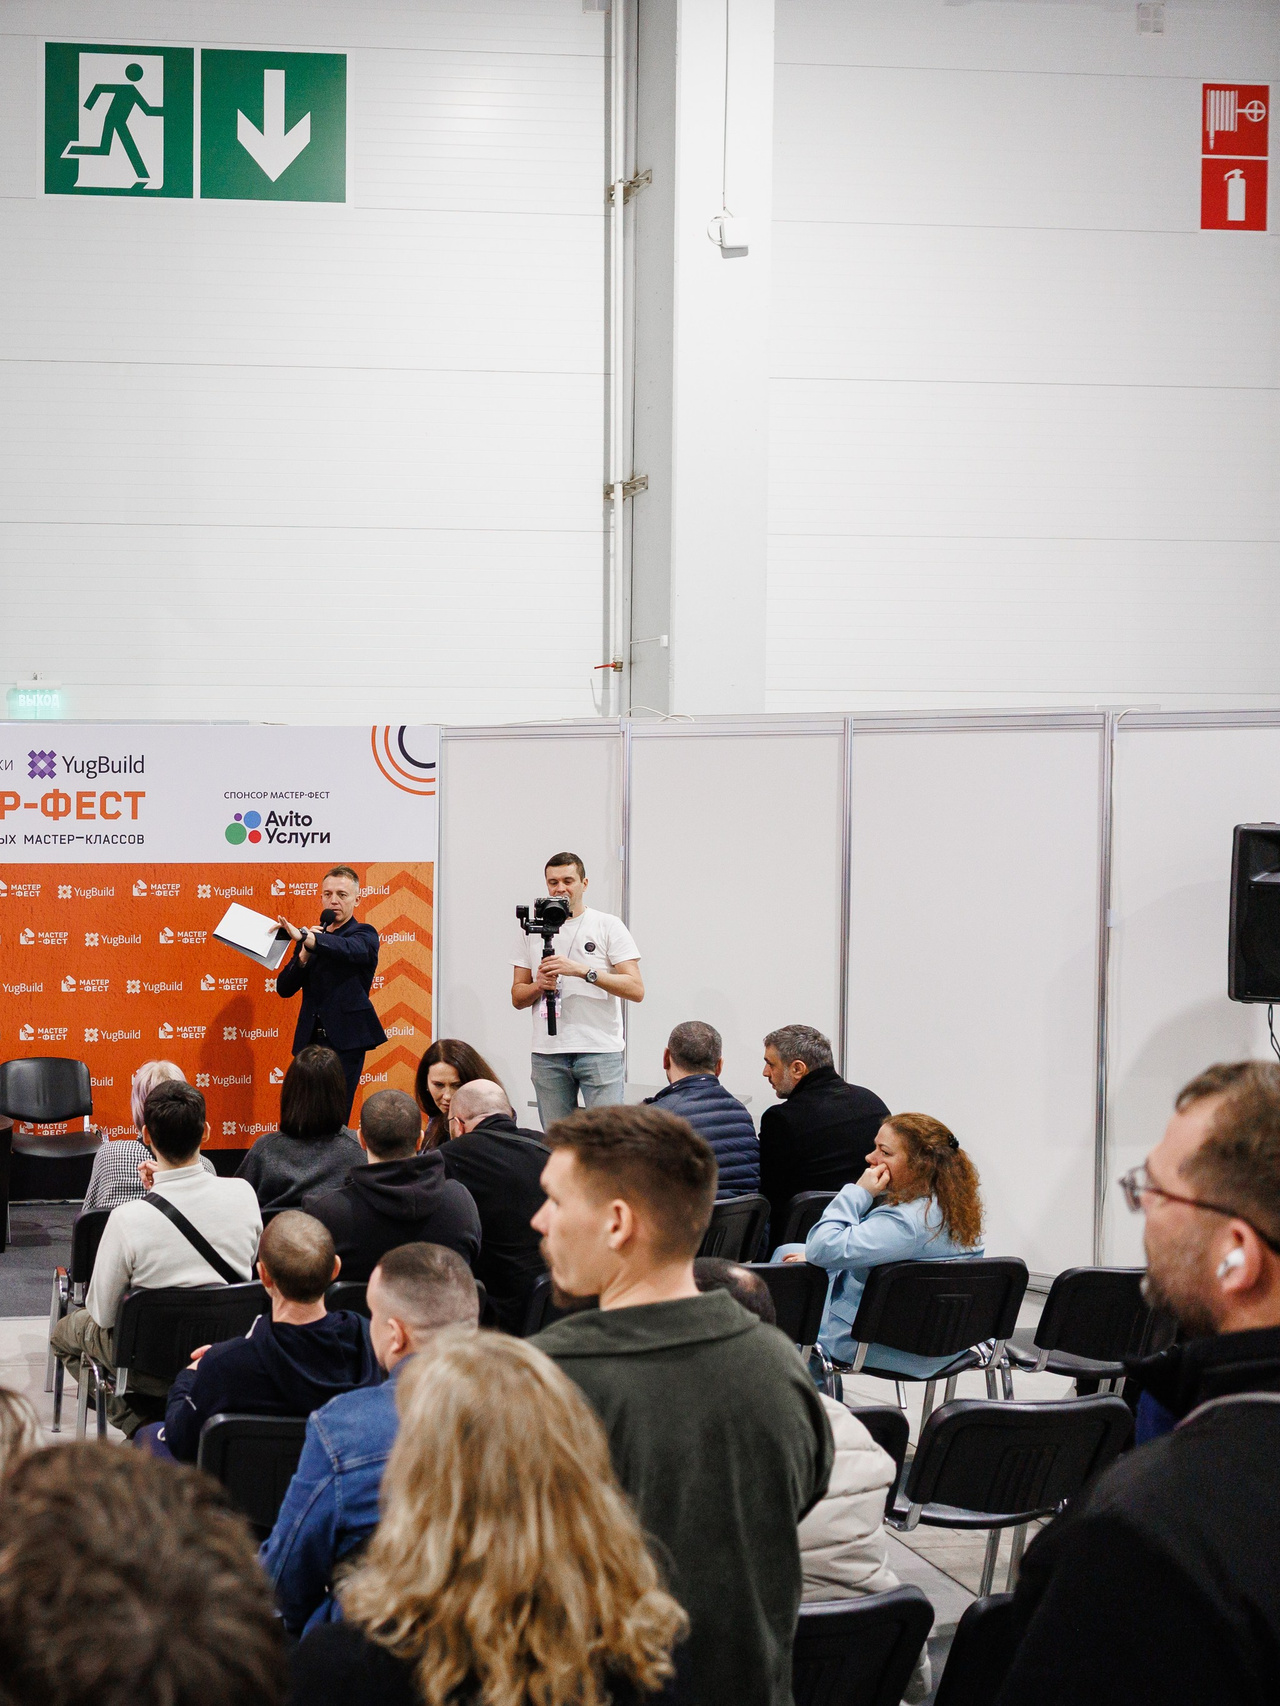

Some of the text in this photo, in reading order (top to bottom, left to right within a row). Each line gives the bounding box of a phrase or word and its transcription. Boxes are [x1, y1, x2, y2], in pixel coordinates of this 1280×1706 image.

[18, 694, 60, 708] ВЫХОД
[62, 754, 145, 780] YugBuild
[223, 791, 330, 800] СПОНСОР МАСТЕР-ФЕСТ
[265, 810, 313, 827] Avito
[265, 828, 331, 847] Услуги
[10, 883, 42, 891] МАСТЕР
[73, 886, 115, 899] YugBuild
[150, 889, 180, 897] -ФЕСТ
[213, 885, 254, 898] YugBuild
[10, 890, 41, 898] -ФЕСТ
[100, 933, 142, 946] YugBuild
[176, 930, 208, 938] МАСТЕР
[2, 982, 44, 995] YugBuild
[79, 978, 110, 986] МАСТЕР
[142, 980, 183, 994] YugBuild
[79, 985, 110, 993] -ФЕСТ
[100, 1029, 141, 1042] YugBuild
[176, 1025, 207, 1033] МАСТЕР
[238, 1027, 279, 1040] YugBuild
[384, 1025, 415, 1039] gBuild
[37, 1033, 68, 1041] -ФЕСТ
[90, 1077, 114, 1087] Build
[211, 1074, 252, 1087] YugBuild
[359, 1071, 388, 1085] gBuild
[37, 1122, 68, 1130] МАСТЕР
[238, 1121, 279, 1135] YugBuild
